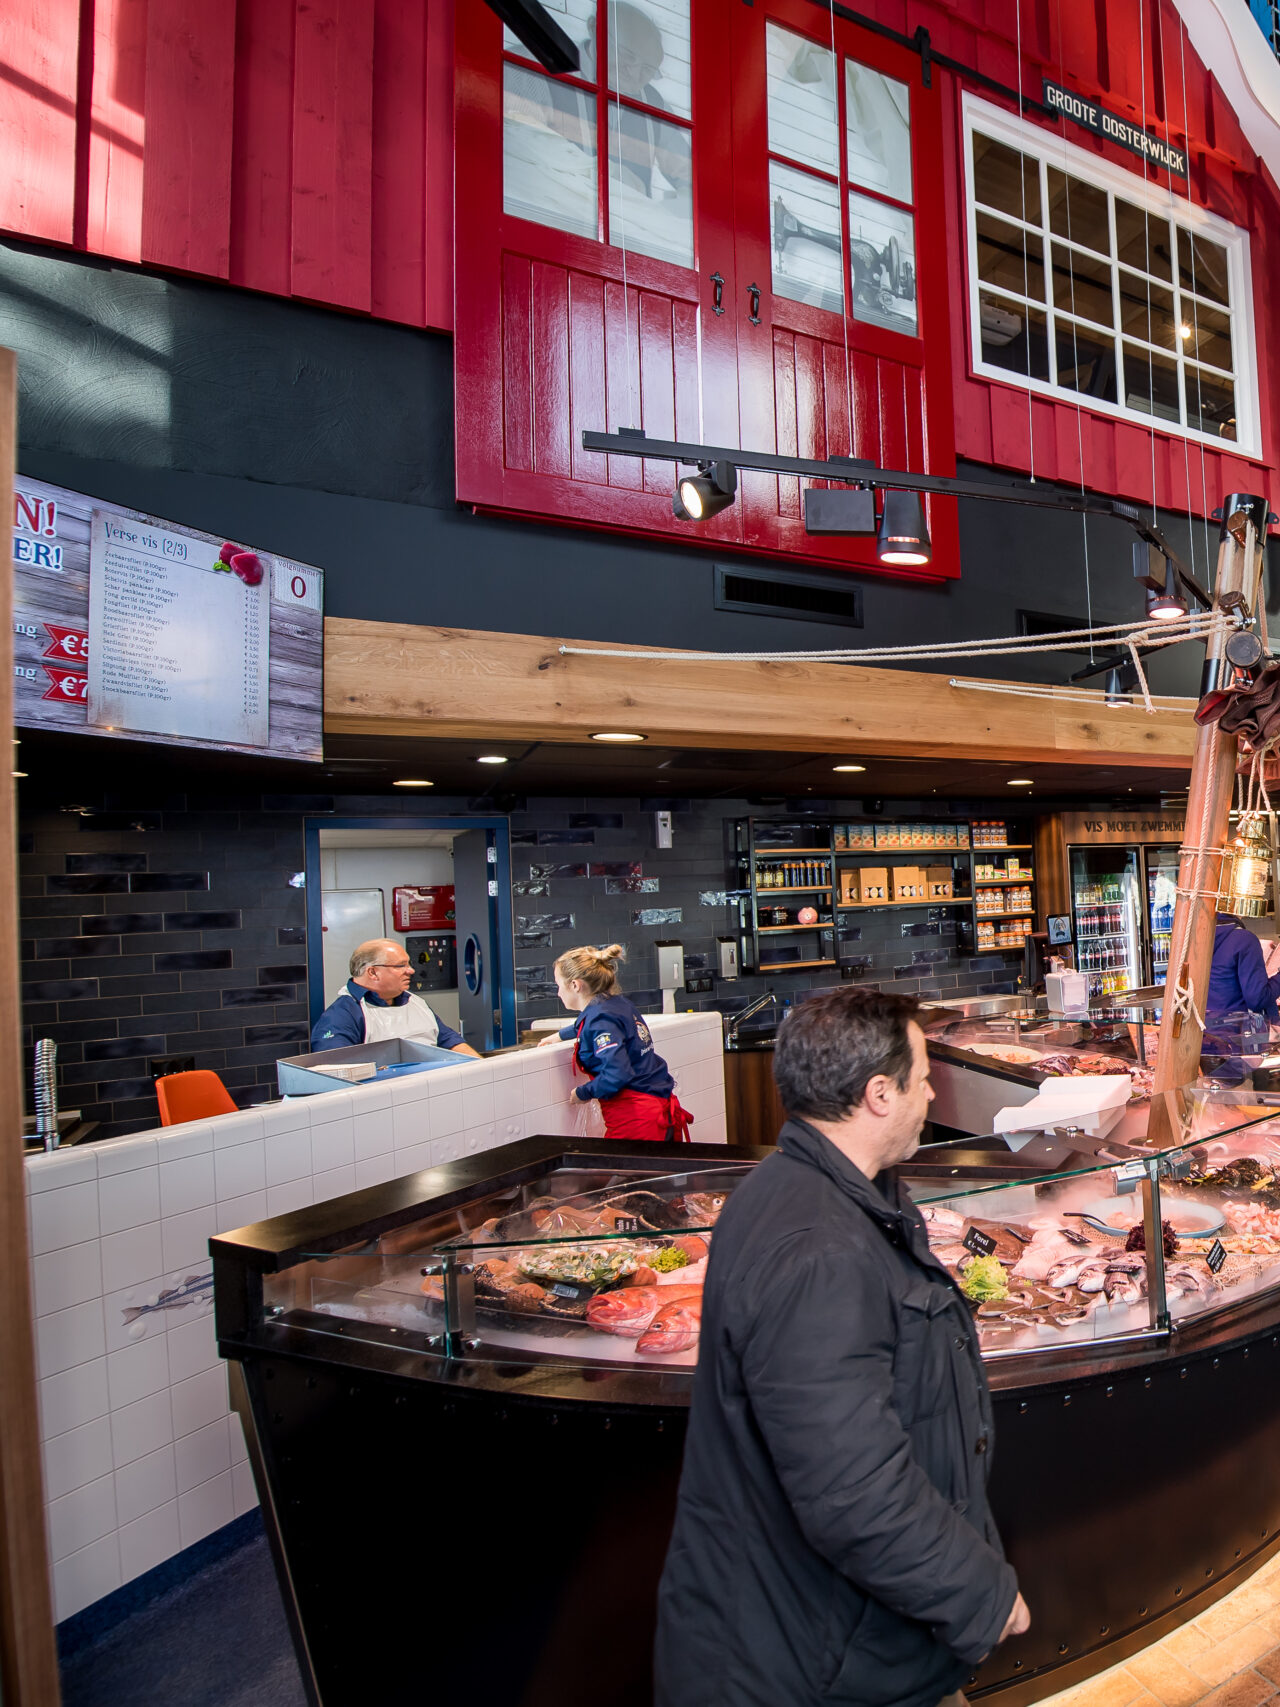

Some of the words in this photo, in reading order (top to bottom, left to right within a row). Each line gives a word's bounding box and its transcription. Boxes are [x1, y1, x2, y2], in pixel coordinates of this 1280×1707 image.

[1046, 85, 1098, 128] GROOTE
[1102, 113, 1185, 173] OOSTERWIJCK
[14, 537, 62, 570] ER!
[104, 521, 138, 543] Verse
[142, 534, 158, 549] vis
[162, 537, 188, 561] (2/3)
[278, 560, 319, 578] volgnummer
[1084, 820, 1103, 833] VIS
[1107, 820, 1138, 833] MOET
